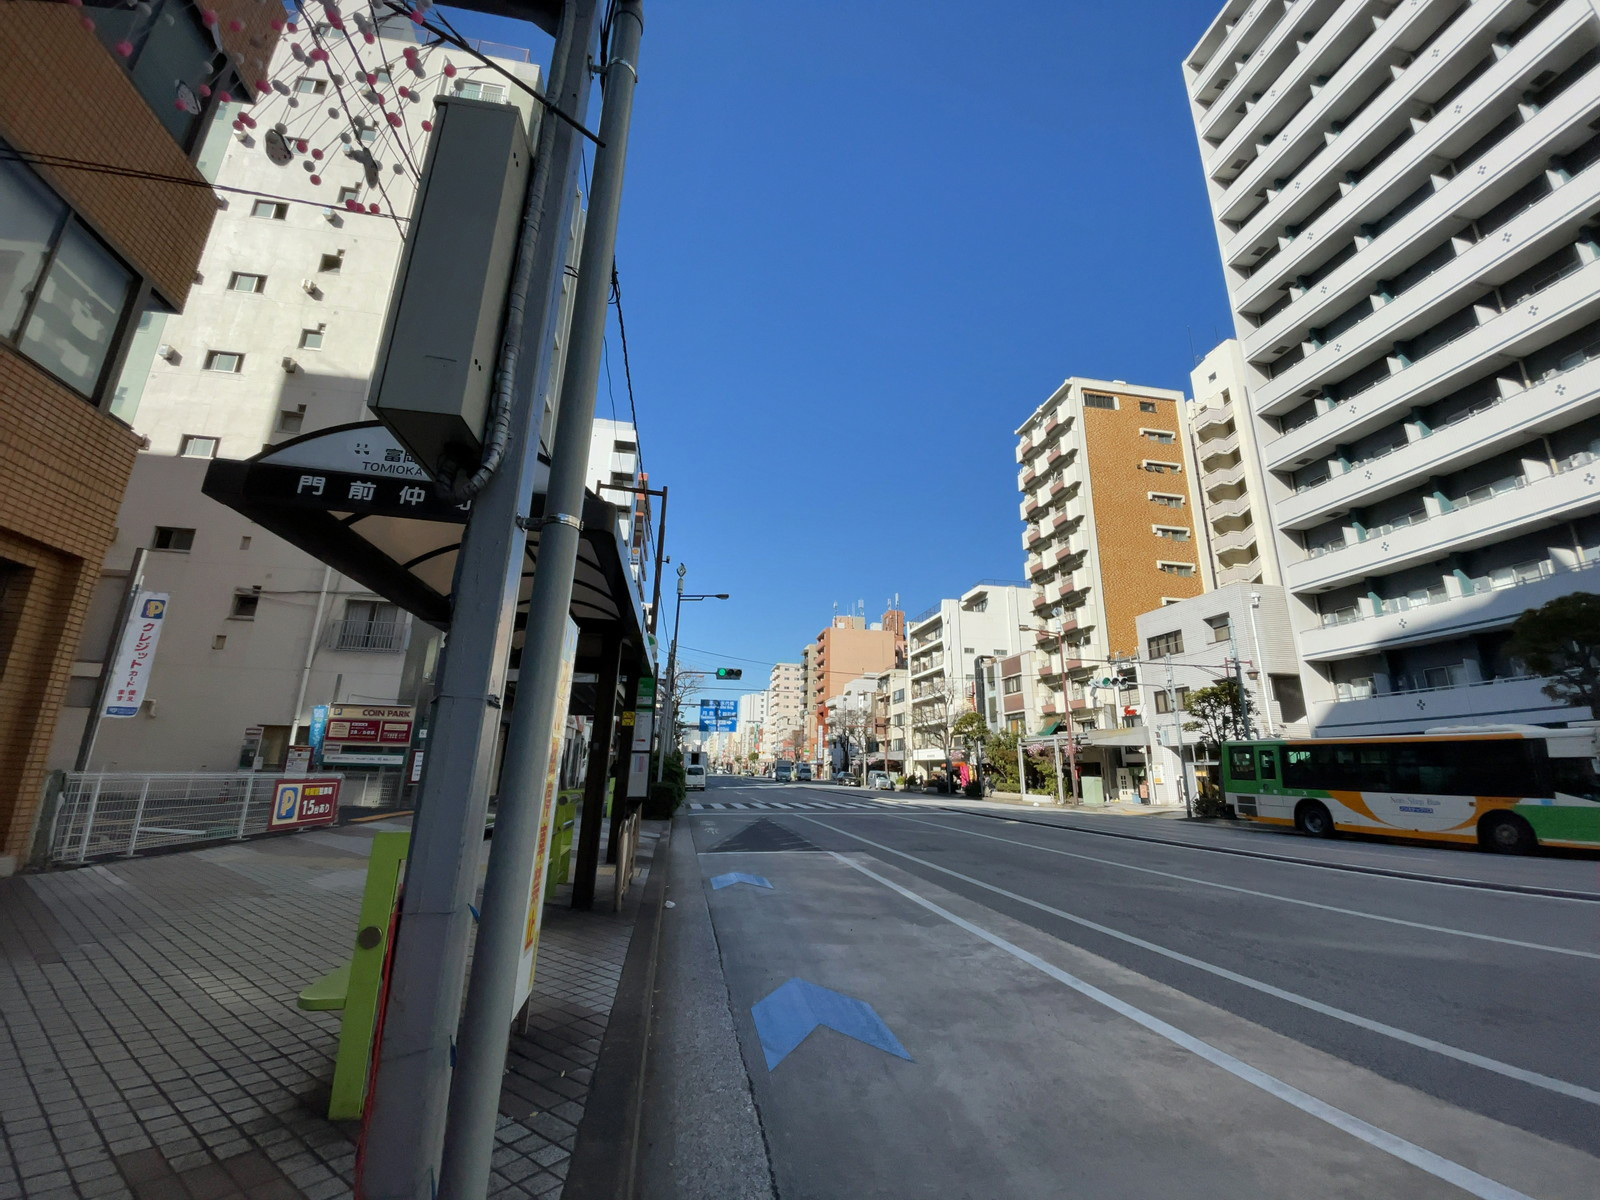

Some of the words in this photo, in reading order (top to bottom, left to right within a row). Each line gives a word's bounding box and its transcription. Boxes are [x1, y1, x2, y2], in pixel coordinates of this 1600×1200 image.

[361, 461, 423, 476] TOMIOKA
[297, 475, 471, 511] 門前仲
[127, 622, 155, 688] クレジットカード
[362, 709, 385, 717] COIN
[387, 710, 411, 718] PARK
